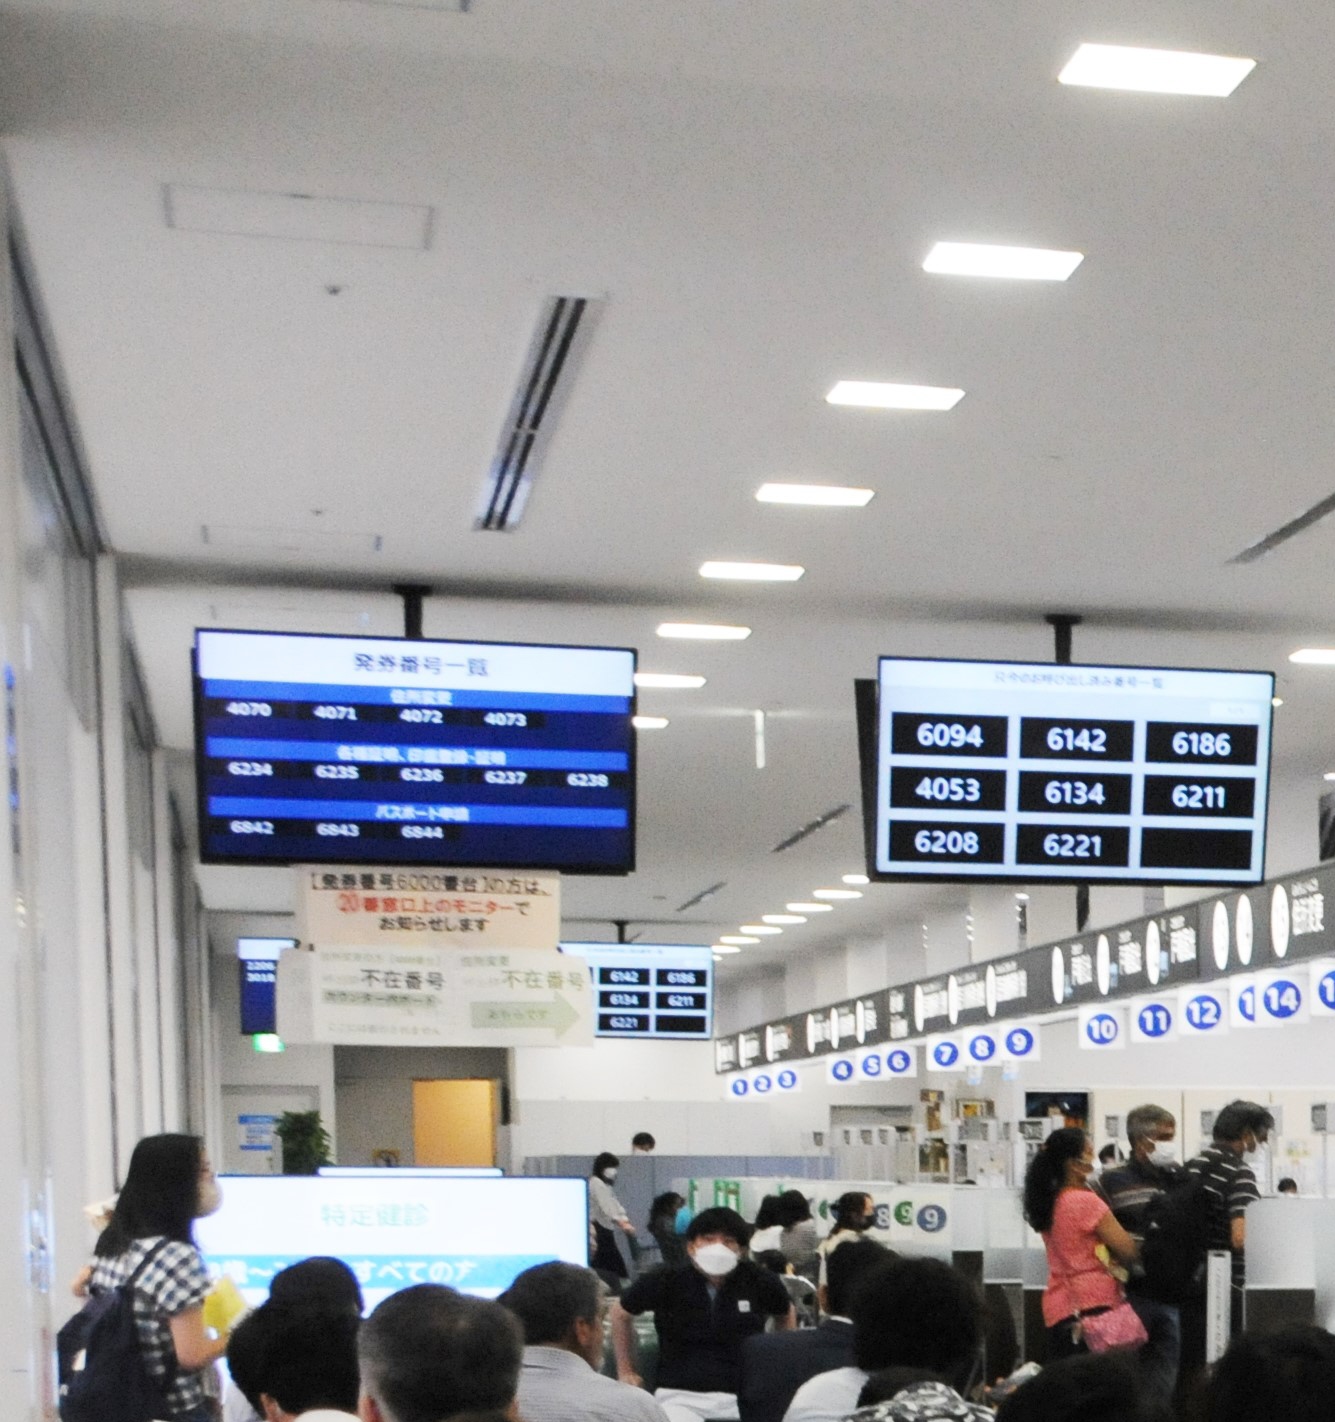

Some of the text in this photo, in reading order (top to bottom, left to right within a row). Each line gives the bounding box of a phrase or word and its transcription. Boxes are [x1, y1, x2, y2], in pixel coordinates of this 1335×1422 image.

[226, 702, 527, 727] 4070 4071 4072 4073
[917, 722, 1232, 756] 6094 6142 6186
[228, 761, 273, 776] 6234
[315, 765, 360, 779] 6235
[400, 768, 444, 782] 6236
[484, 771, 527, 785] 6237
[915, 776, 1225, 808] 4053 6134 6211
[914, 830, 1102, 858] 6208 6221
[360, 968, 444, 991] 不在番号
[501, 969, 586, 992] 不在番号
[1266, 987, 1299, 1012] 14
[1142, 1010, 1167, 1032] 11
[1188, 1000, 1218, 1024] 12
[1089, 1018, 1116, 1040] 10
[975, 1038, 990, 1057] 8
[1011, 1032, 1027, 1052] 9
[939, 1045, 953, 1063] 7
[320, 1202, 429, 1228] 特定健診
[901, 1204, 913, 1222] 9
[923, 1207, 940, 1229] 9
